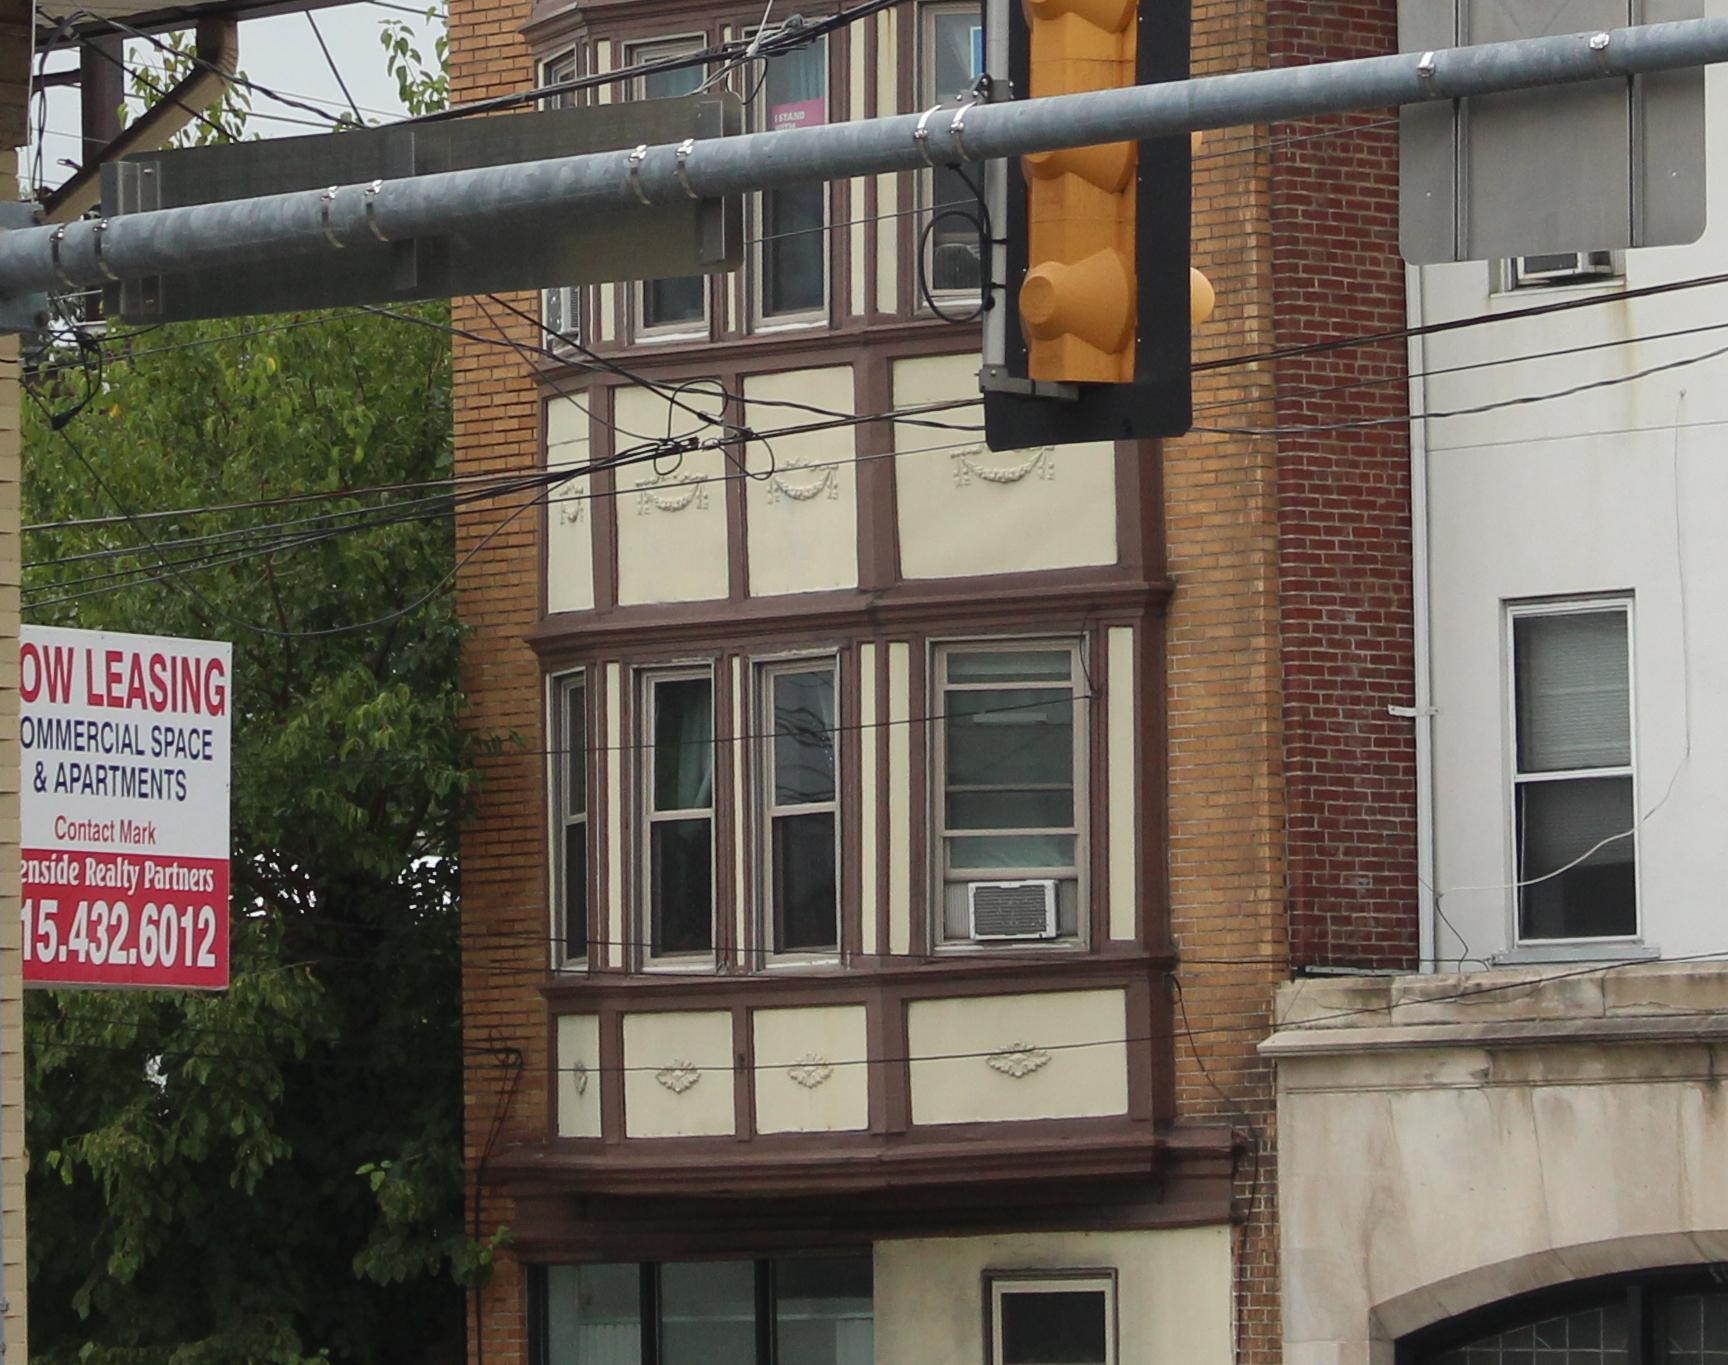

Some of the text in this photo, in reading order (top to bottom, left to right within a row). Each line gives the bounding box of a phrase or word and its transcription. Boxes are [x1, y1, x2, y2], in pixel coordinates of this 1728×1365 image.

[779, 111, 805, 122] STAND
[86, 649, 225, 716] LEASING
[151, 726, 213, 760] SPACE
[34, 763, 187, 801] & APARTMENTS
[54, 816, 156, 845] Contact Mark
[85, 857, 139, 895] Realty
[144, 861, 213, 892] Partners
